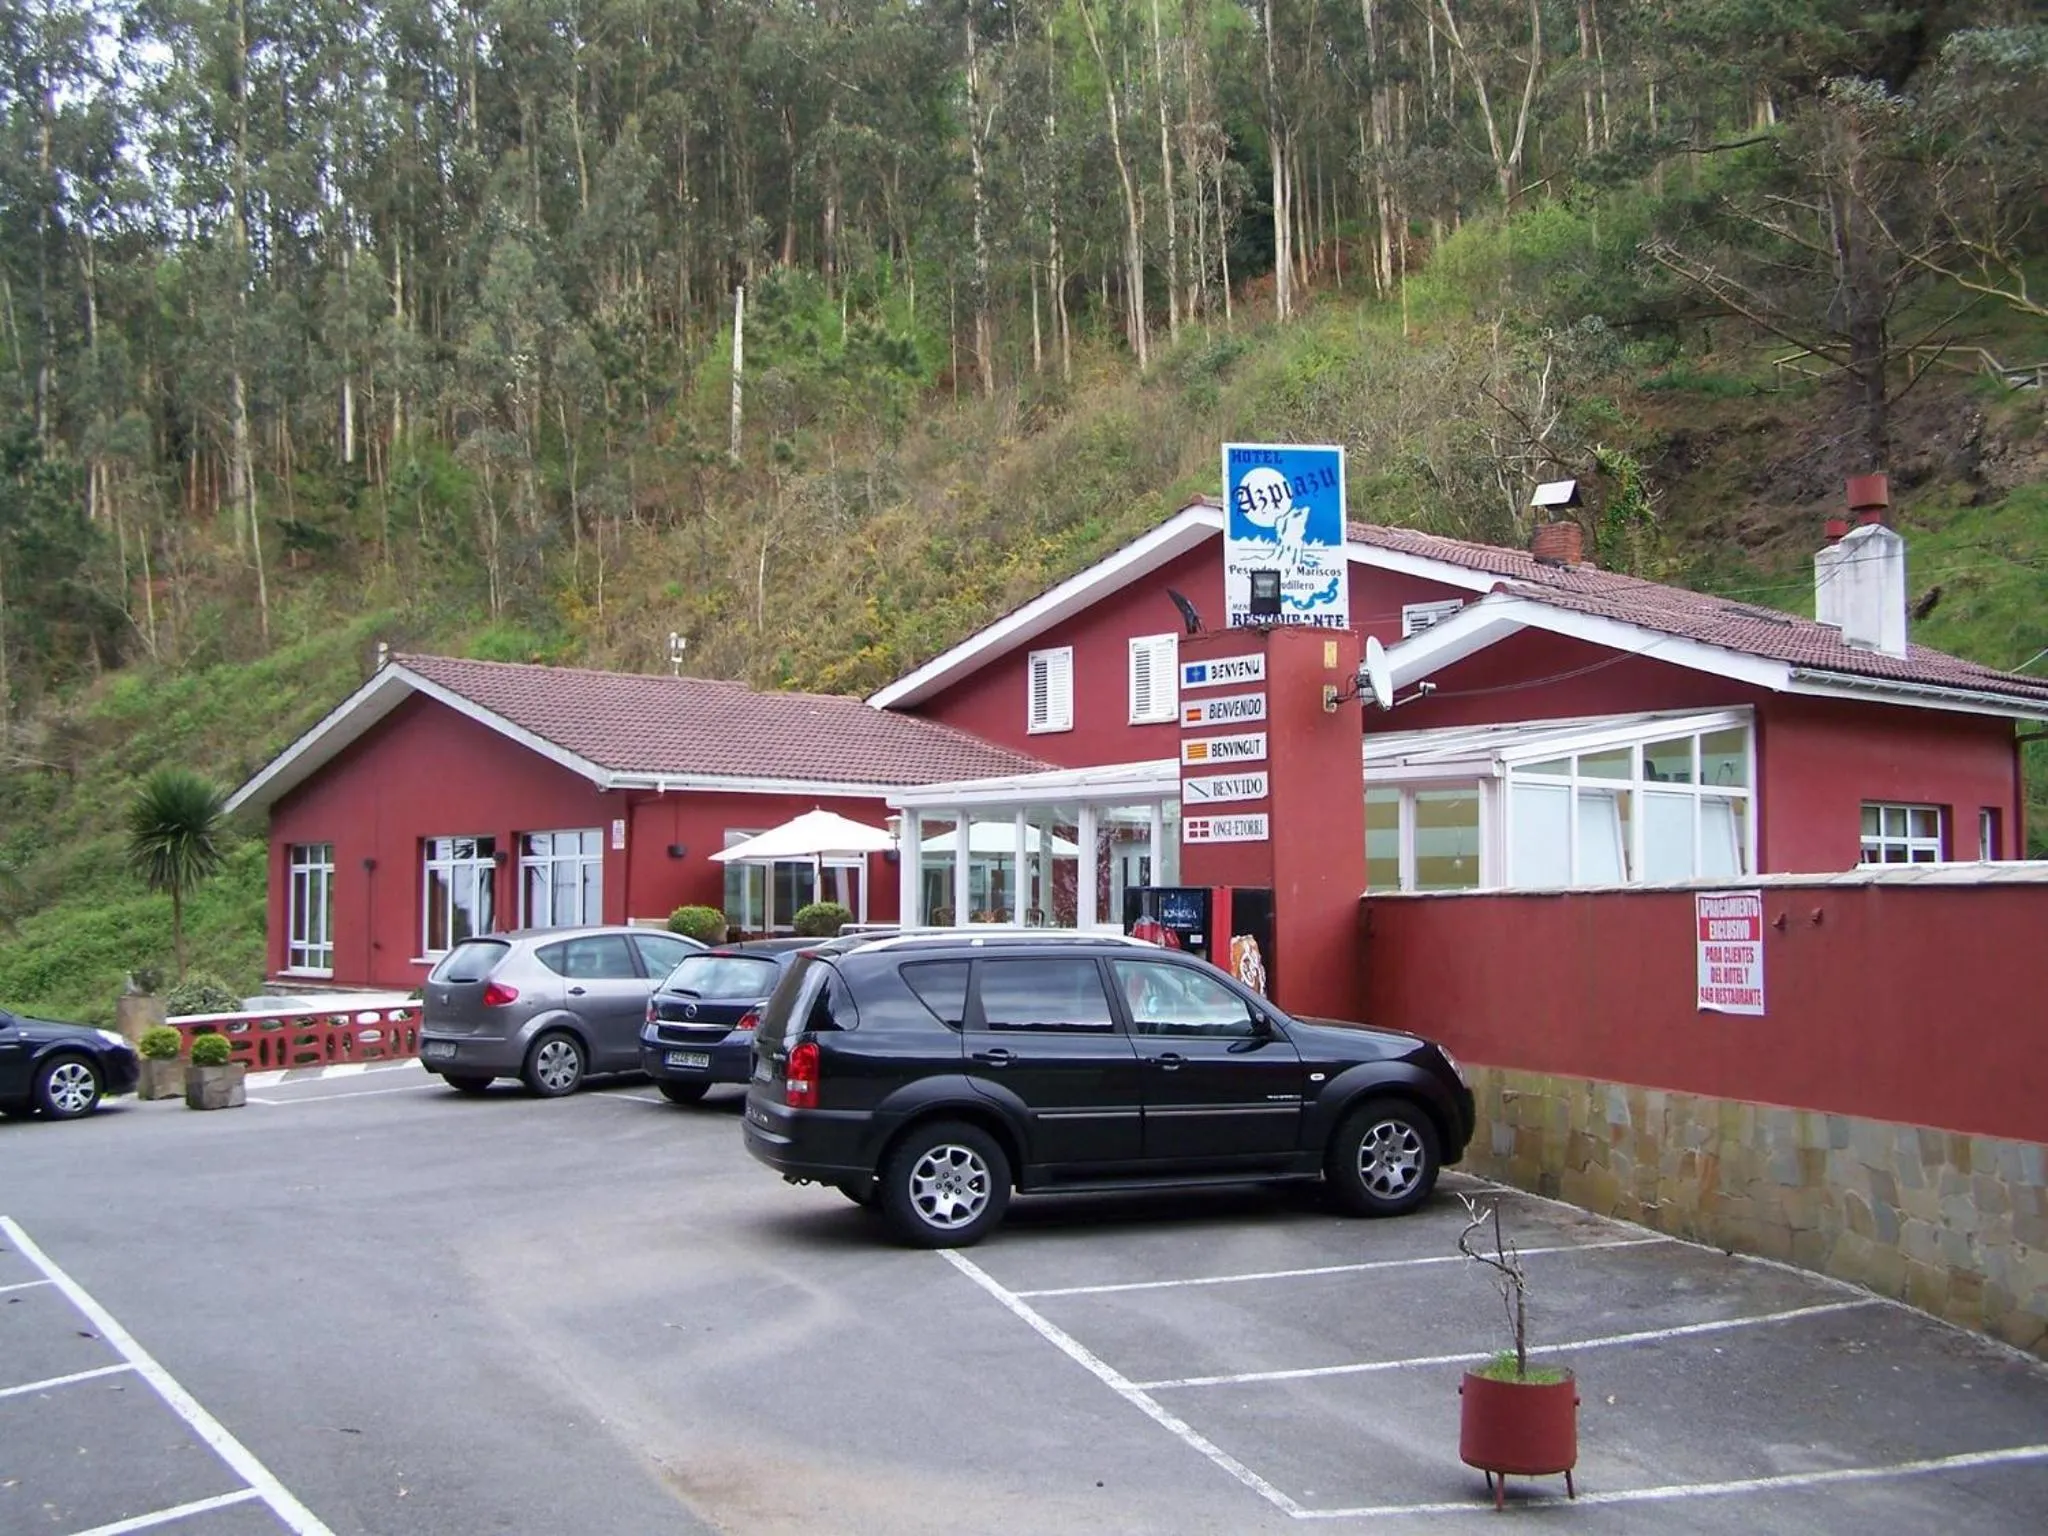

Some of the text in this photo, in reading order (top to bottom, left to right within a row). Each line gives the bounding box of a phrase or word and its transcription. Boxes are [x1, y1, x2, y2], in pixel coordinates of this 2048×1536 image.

[1231, 449, 1284, 465] HOTEL
[1232, 466, 1337, 517] Azpiazu
[1285, 567, 1291, 577] y
[1296, 566, 1342, 577] Mariscos
[1281, 581, 1315, 591] udillero
[1210, 661, 1260, 680] BENVENU
[1208, 698, 1262, 720] BIENVENIDO
[1211, 739, 1261, 758] BENVINGUT
[1212, 778, 1263, 797] BENVIDO
[1700, 898, 1758, 918] APARCAMIENTO
[1709, 919, 1750, 940] EXCLUSIVO
[1704, 946, 1754, 964] PARA CLIENTES
[1710, 966, 1750, 985] DEL HOTEL Y
[1700, 987, 1762, 1006] BAR RESTAURANTE
